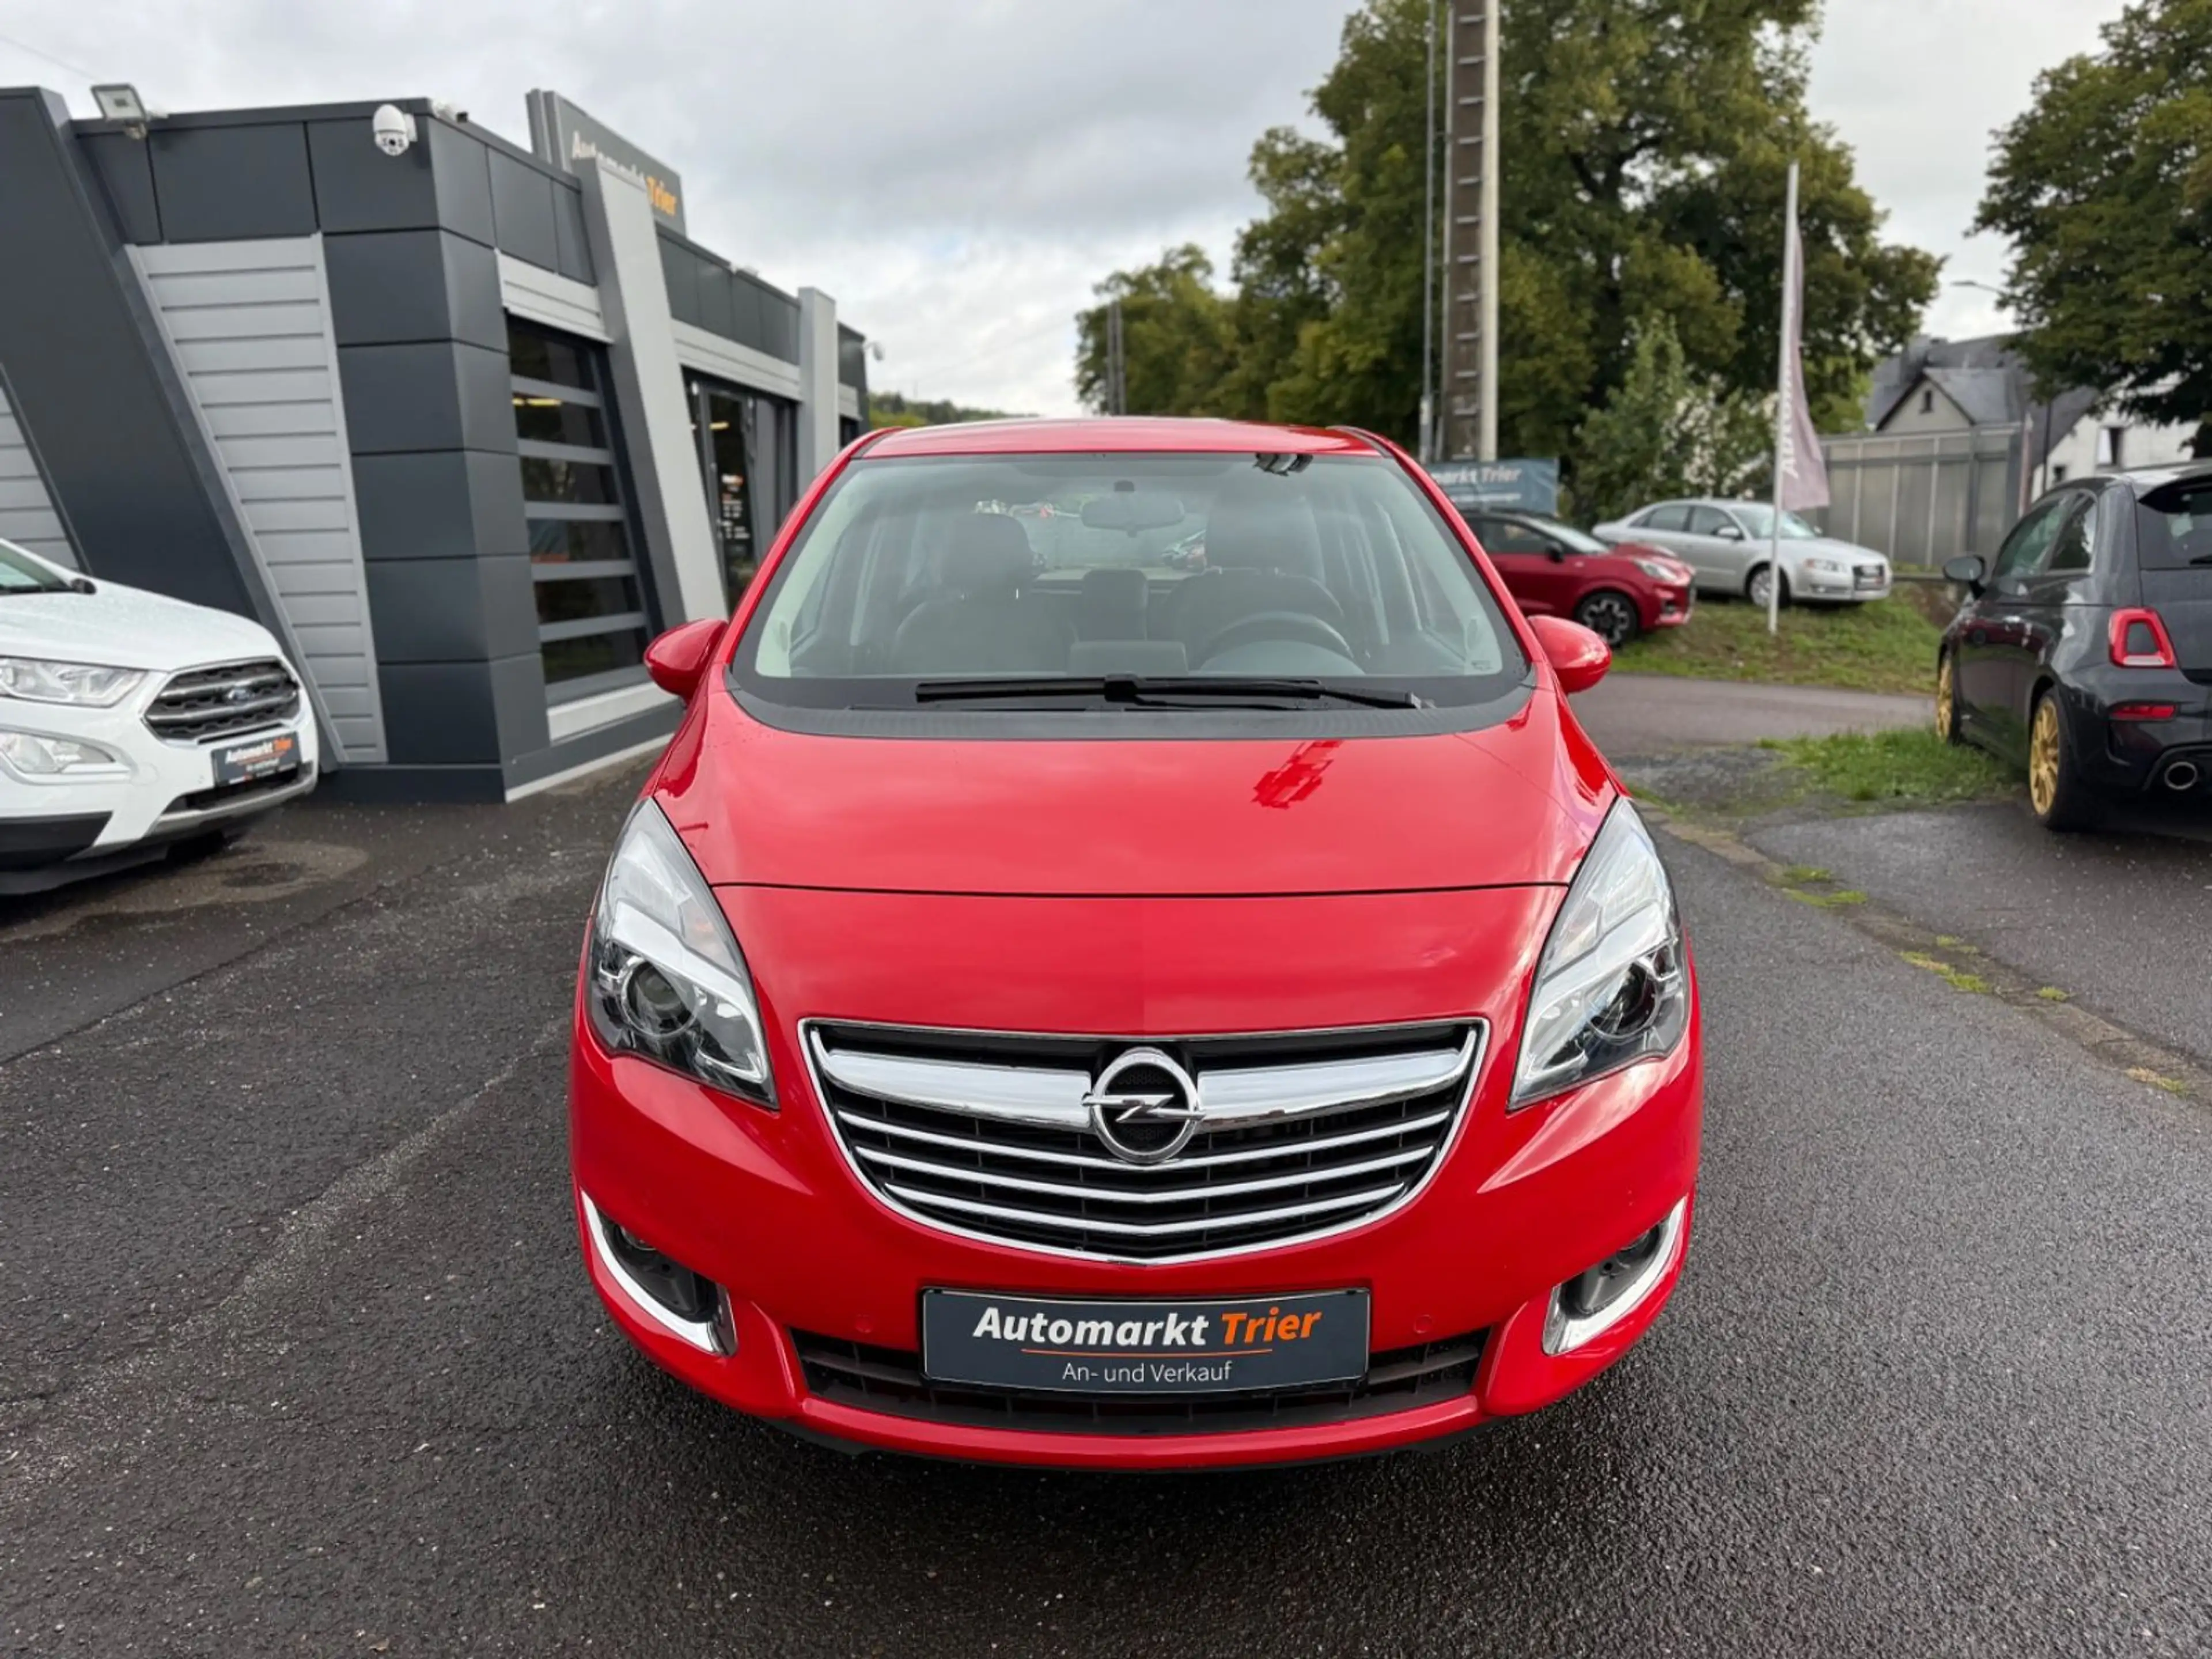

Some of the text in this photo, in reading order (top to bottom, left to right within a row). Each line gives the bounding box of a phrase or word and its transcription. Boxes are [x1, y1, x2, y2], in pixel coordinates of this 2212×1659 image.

[972, 1306, 1322, 1346] Automarkt Trier
[1062, 1360, 1233, 1382] An- und Verkauf
